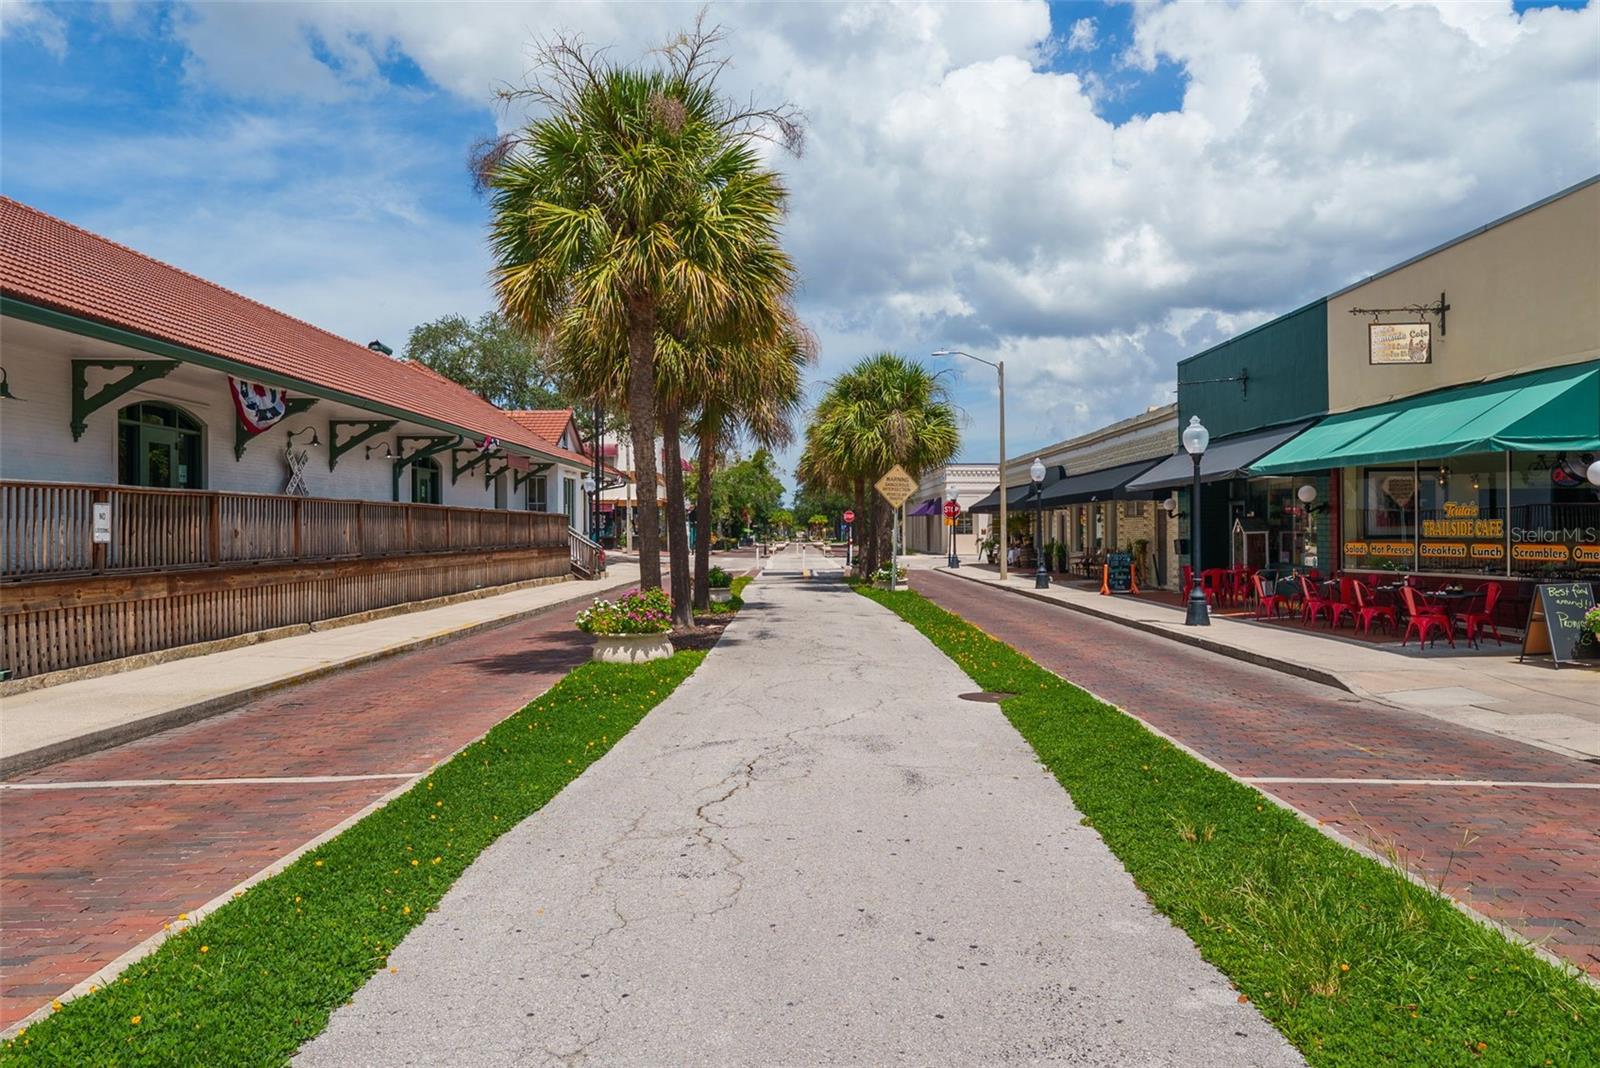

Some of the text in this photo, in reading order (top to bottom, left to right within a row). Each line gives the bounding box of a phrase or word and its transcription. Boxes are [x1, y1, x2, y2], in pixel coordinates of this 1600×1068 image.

[1409, 329, 1428, 338] Cafe
[1423, 519, 1503, 537] TRAILSIDE CAFE
[1345, 545, 1367, 554] Salads
[1371, 544, 1413, 554] Hot Presses
[1421, 545, 1465, 555] Breakfast
[1472, 546, 1502, 556] Lunch
[1513, 546, 1567, 558] Scramblers
[1547, 587, 1570, 597] Best
